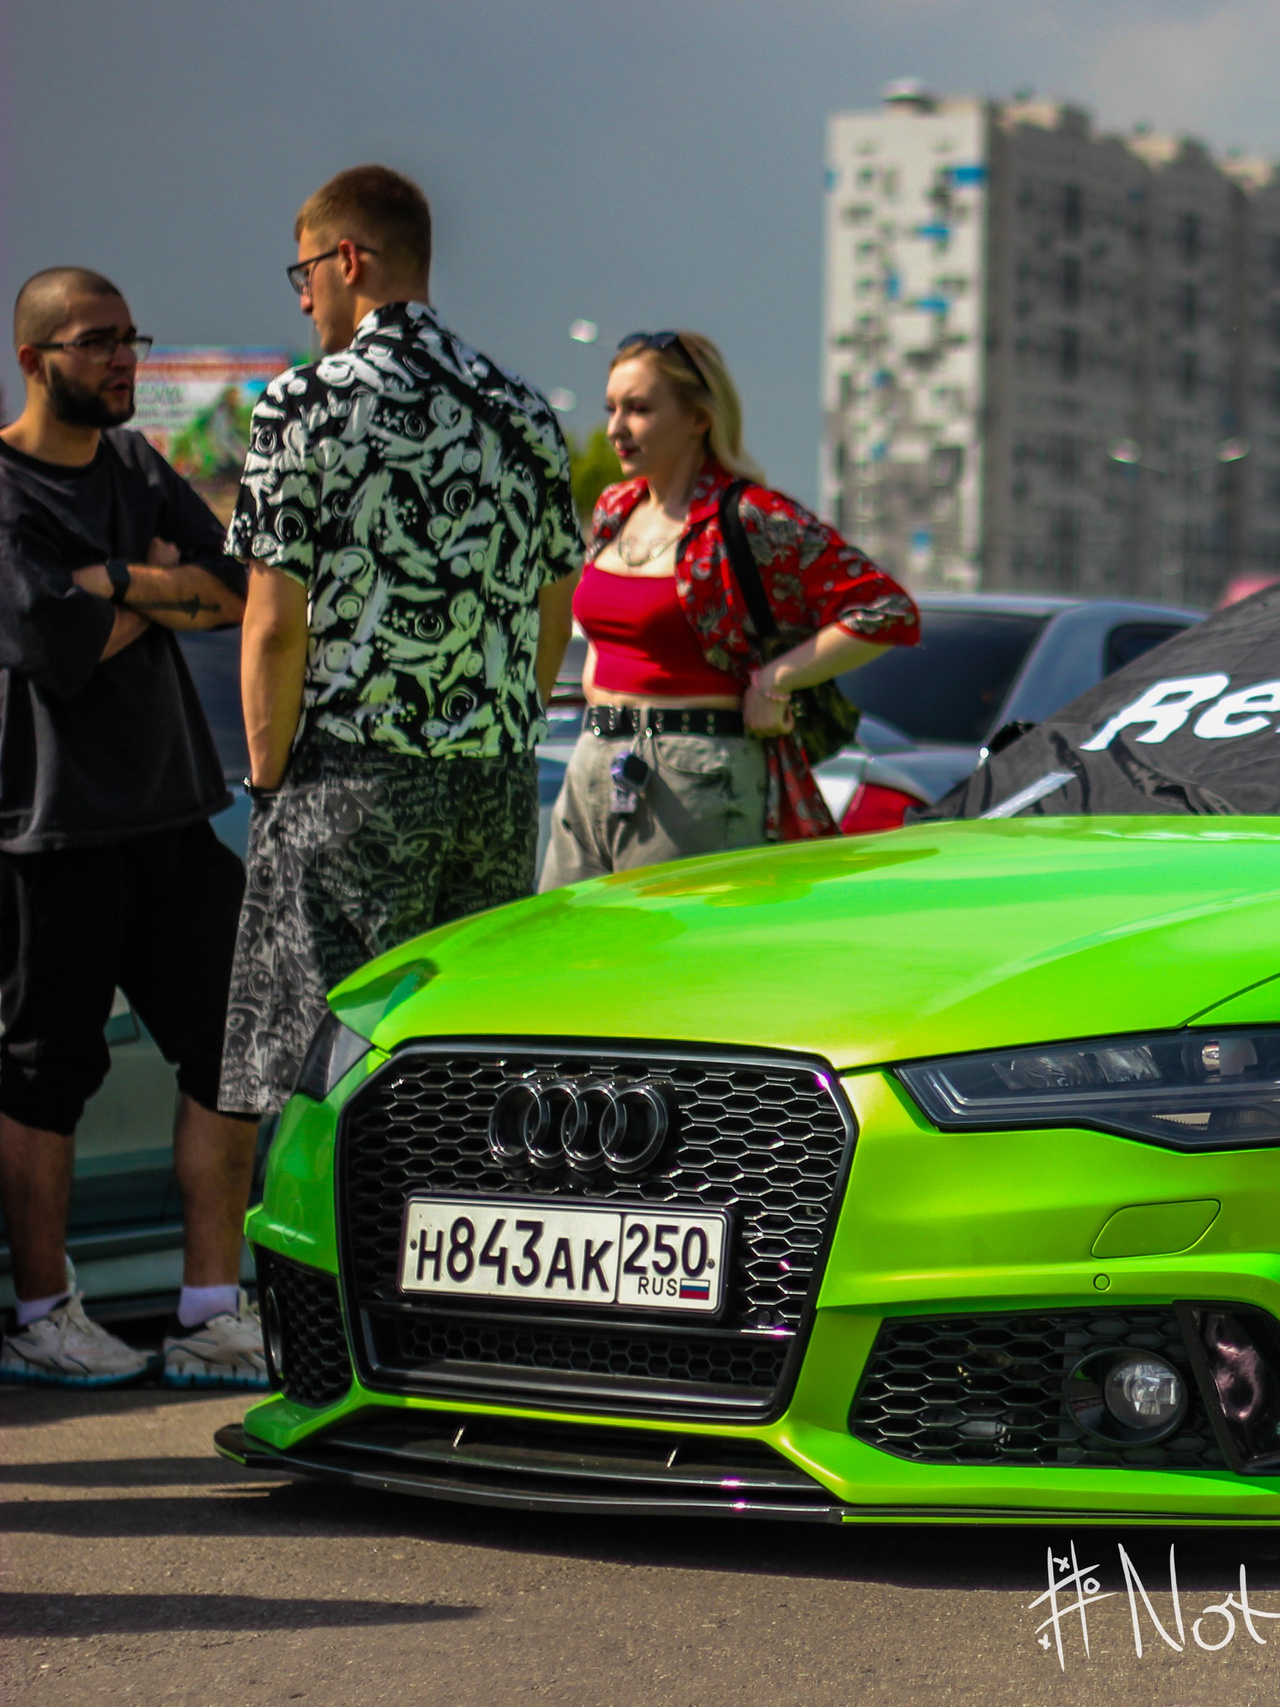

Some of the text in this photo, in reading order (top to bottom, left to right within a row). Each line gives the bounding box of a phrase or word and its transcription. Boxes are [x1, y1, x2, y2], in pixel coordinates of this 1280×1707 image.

[415, 1215, 710, 1293] H843AK 250
[637, 1276, 678, 1297] RUS
